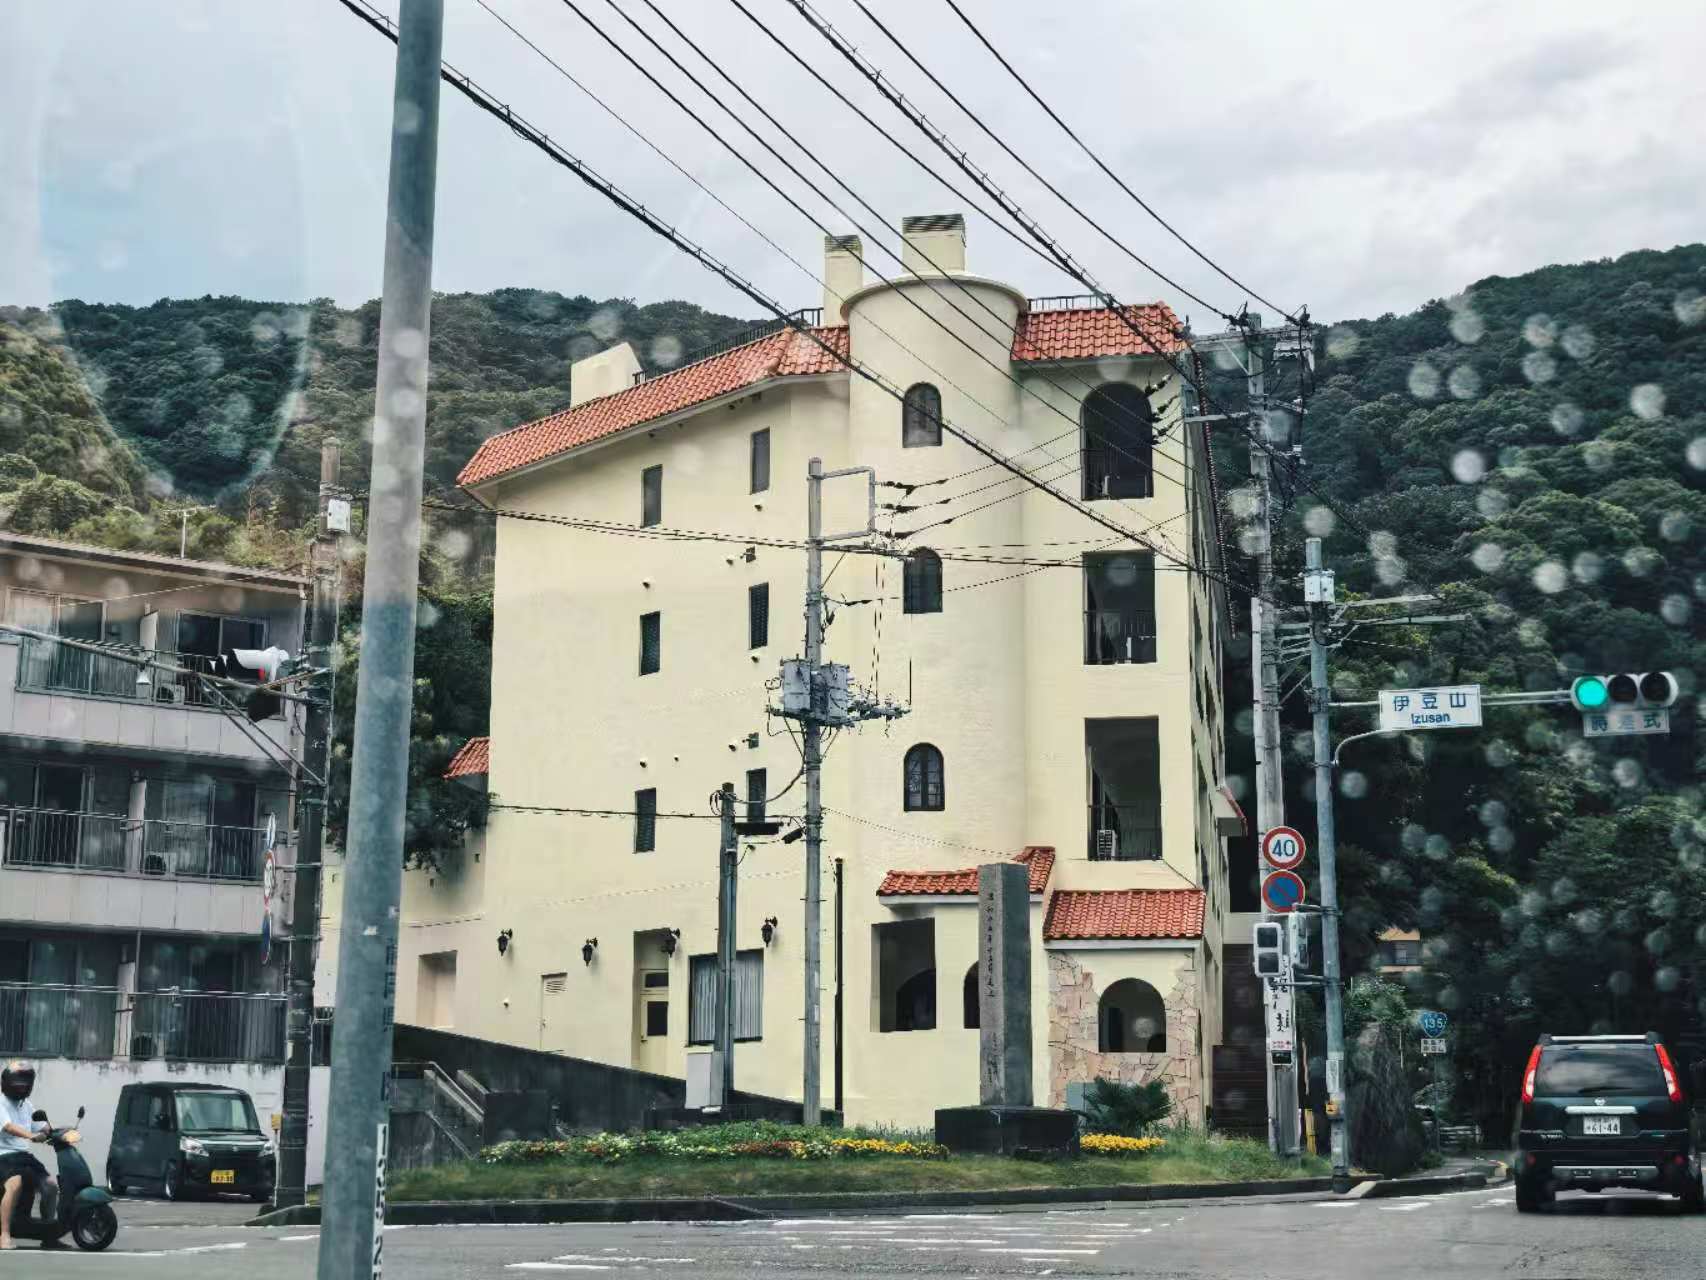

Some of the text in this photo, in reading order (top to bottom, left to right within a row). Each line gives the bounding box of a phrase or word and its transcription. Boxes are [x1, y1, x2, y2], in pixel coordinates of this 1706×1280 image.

[1393, 692, 1466, 711] 伊豆山
[1411, 713, 1451, 724] Izusan
[1272, 839, 1296, 857] 40
[1424, 1017, 1443, 1029] 135
